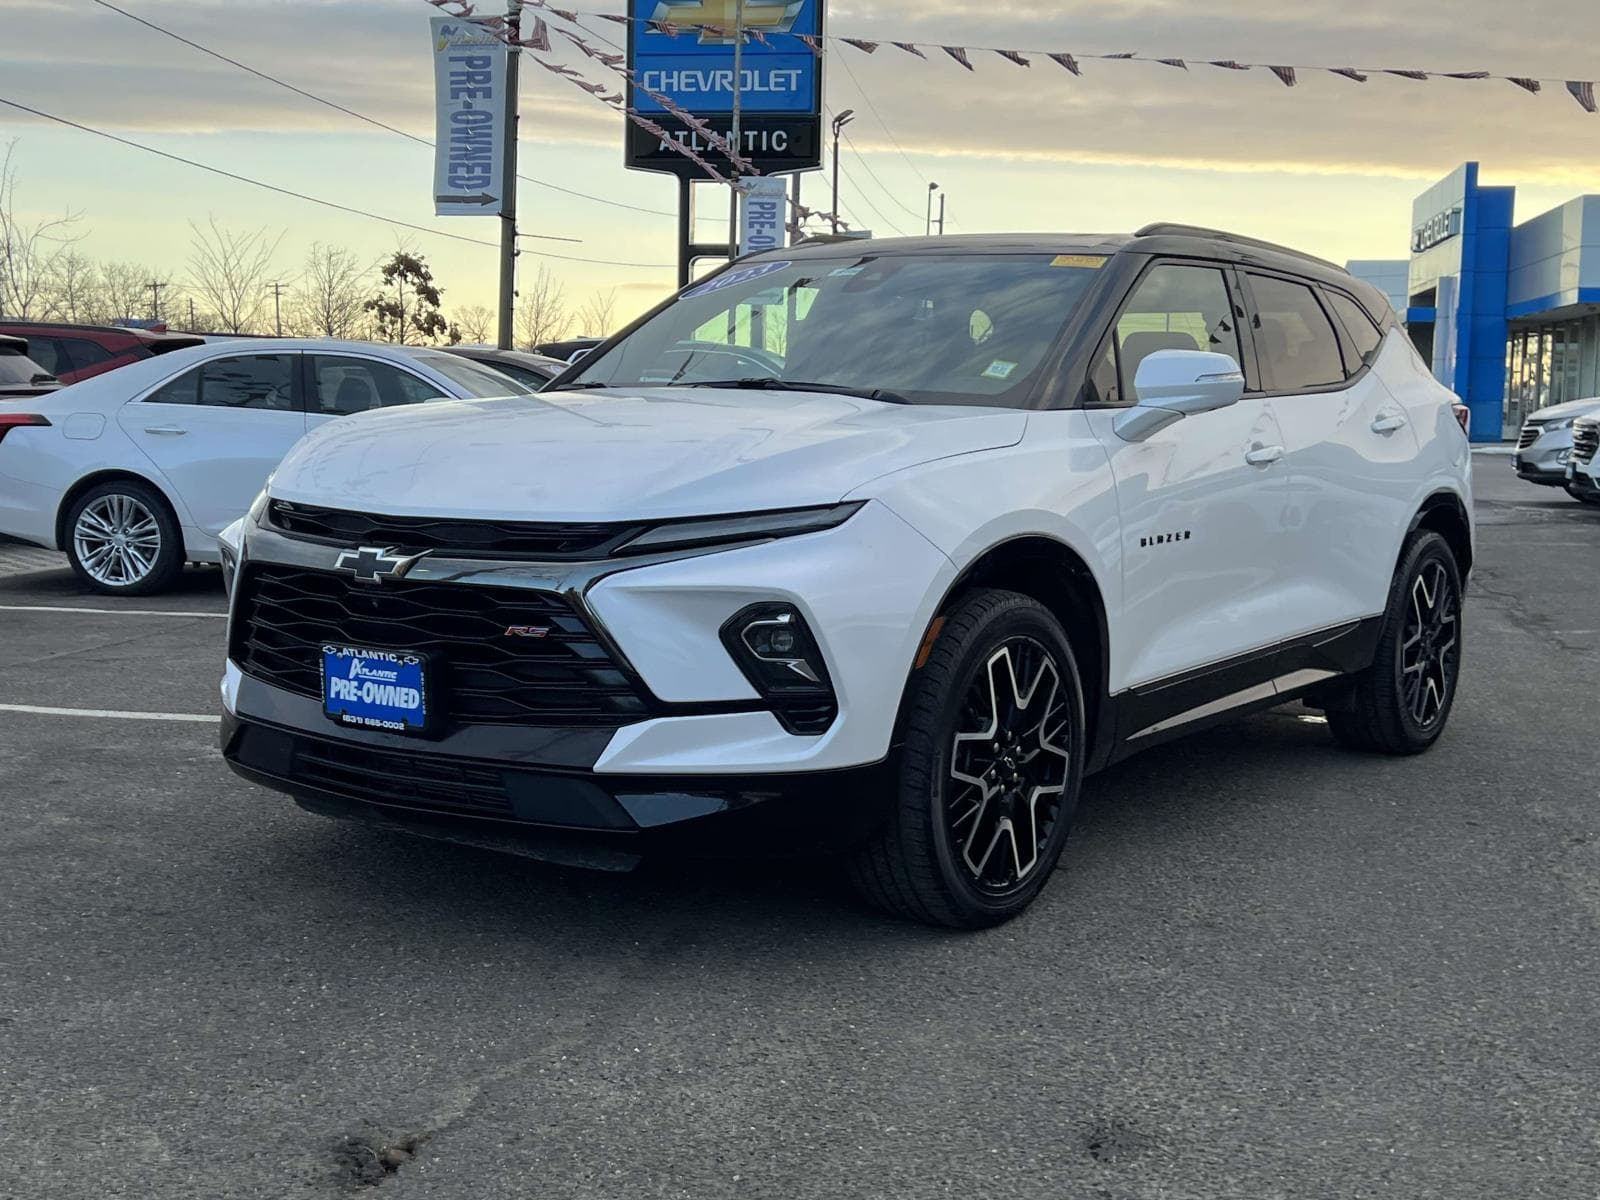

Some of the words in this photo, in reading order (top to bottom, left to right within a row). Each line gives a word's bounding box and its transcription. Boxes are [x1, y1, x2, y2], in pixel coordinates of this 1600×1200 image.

[643, 70, 802, 92] CHEVROLET
[448, 56, 493, 190] PRE-OWNED
[748, 202, 776, 250] PRE-O
[1140, 531, 1190, 547] BLAZER
[504, 626, 549, 638] RS
[342, 648, 398, 662] ATLANTIC
[330, 676, 420, 709] PRE-OWNED
